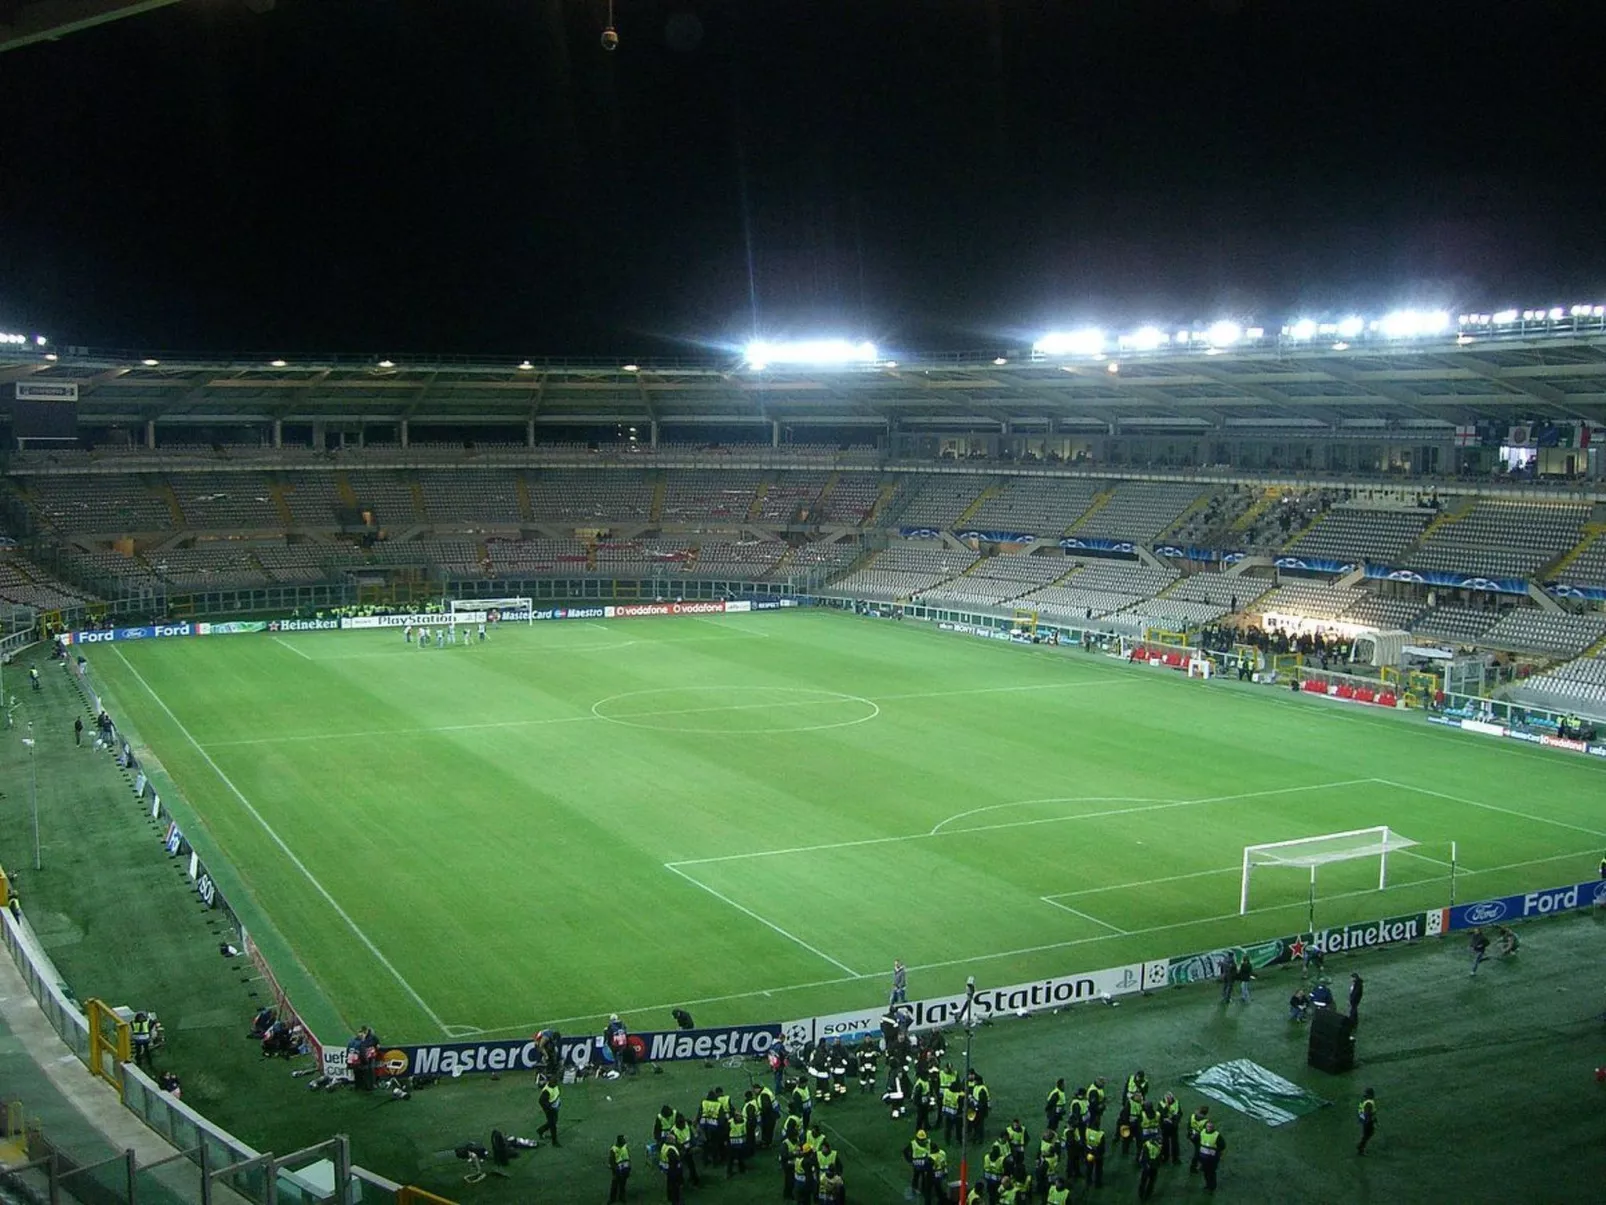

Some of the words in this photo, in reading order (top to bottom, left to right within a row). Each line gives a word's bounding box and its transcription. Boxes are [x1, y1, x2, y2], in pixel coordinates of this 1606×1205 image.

[567, 609, 602, 617] Maestro
[625, 606, 669, 615] vodafone
[682, 603, 724, 612] vodafone
[281, 619, 338, 630] Heineken
[378, 615, 457, 625] PlayStation
[79, 630, 114, 643] Ford
[155, 624, 190, 637] Ford
[1523, 885, 1578, 916] Ford
[1472, 904, 1499, 921] Ford
[1313, 919, 1418, 953] Heineken
[824, 1018, 872, 1035] SONY
[650, 1031, 773, 1060] Maestro
[414, 1039, 592, 1074] MasterCrd
